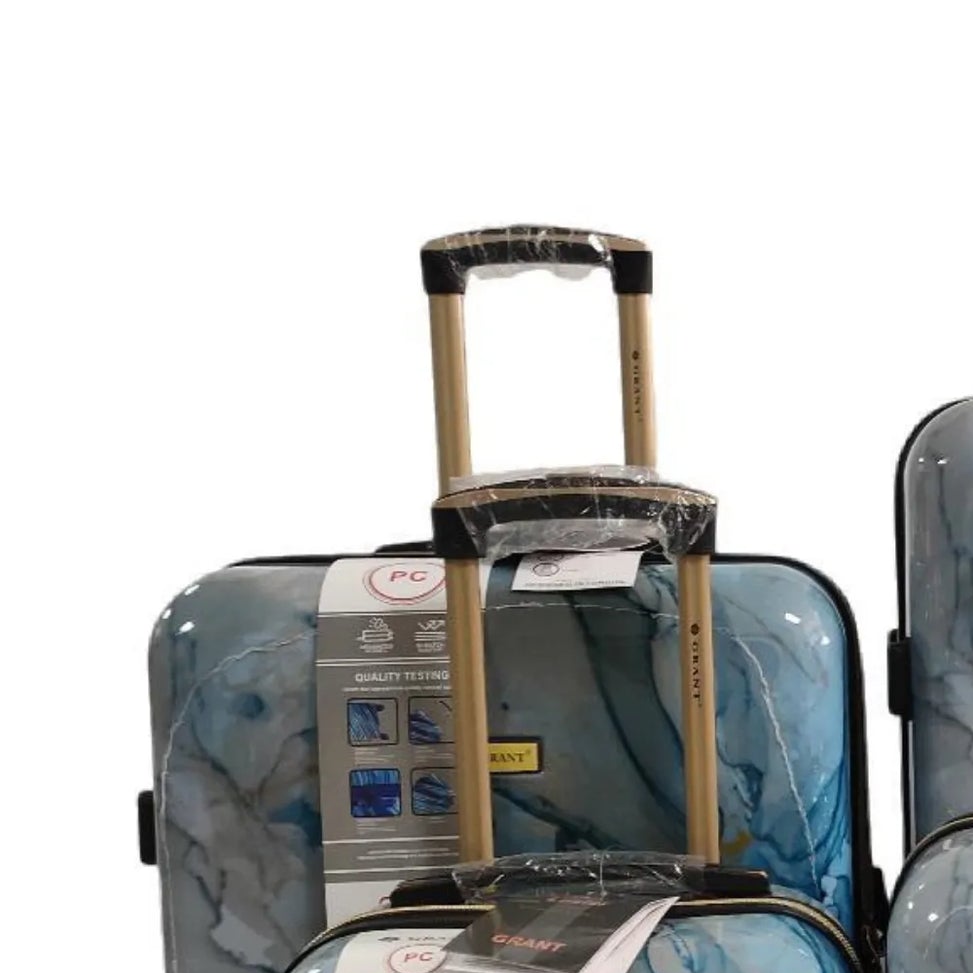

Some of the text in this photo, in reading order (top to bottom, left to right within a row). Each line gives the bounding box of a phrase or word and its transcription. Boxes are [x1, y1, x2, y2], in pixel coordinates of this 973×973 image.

[390, 570, 429, 582] PC
[692, 641, 701, 698] GRANT
[354, 670, 450, 682] QUALITY TESTING
[489, 751, 525, 763] RANT
[491, 934, 567, 952] GRANT
[403, 952, 433, 963] PC
